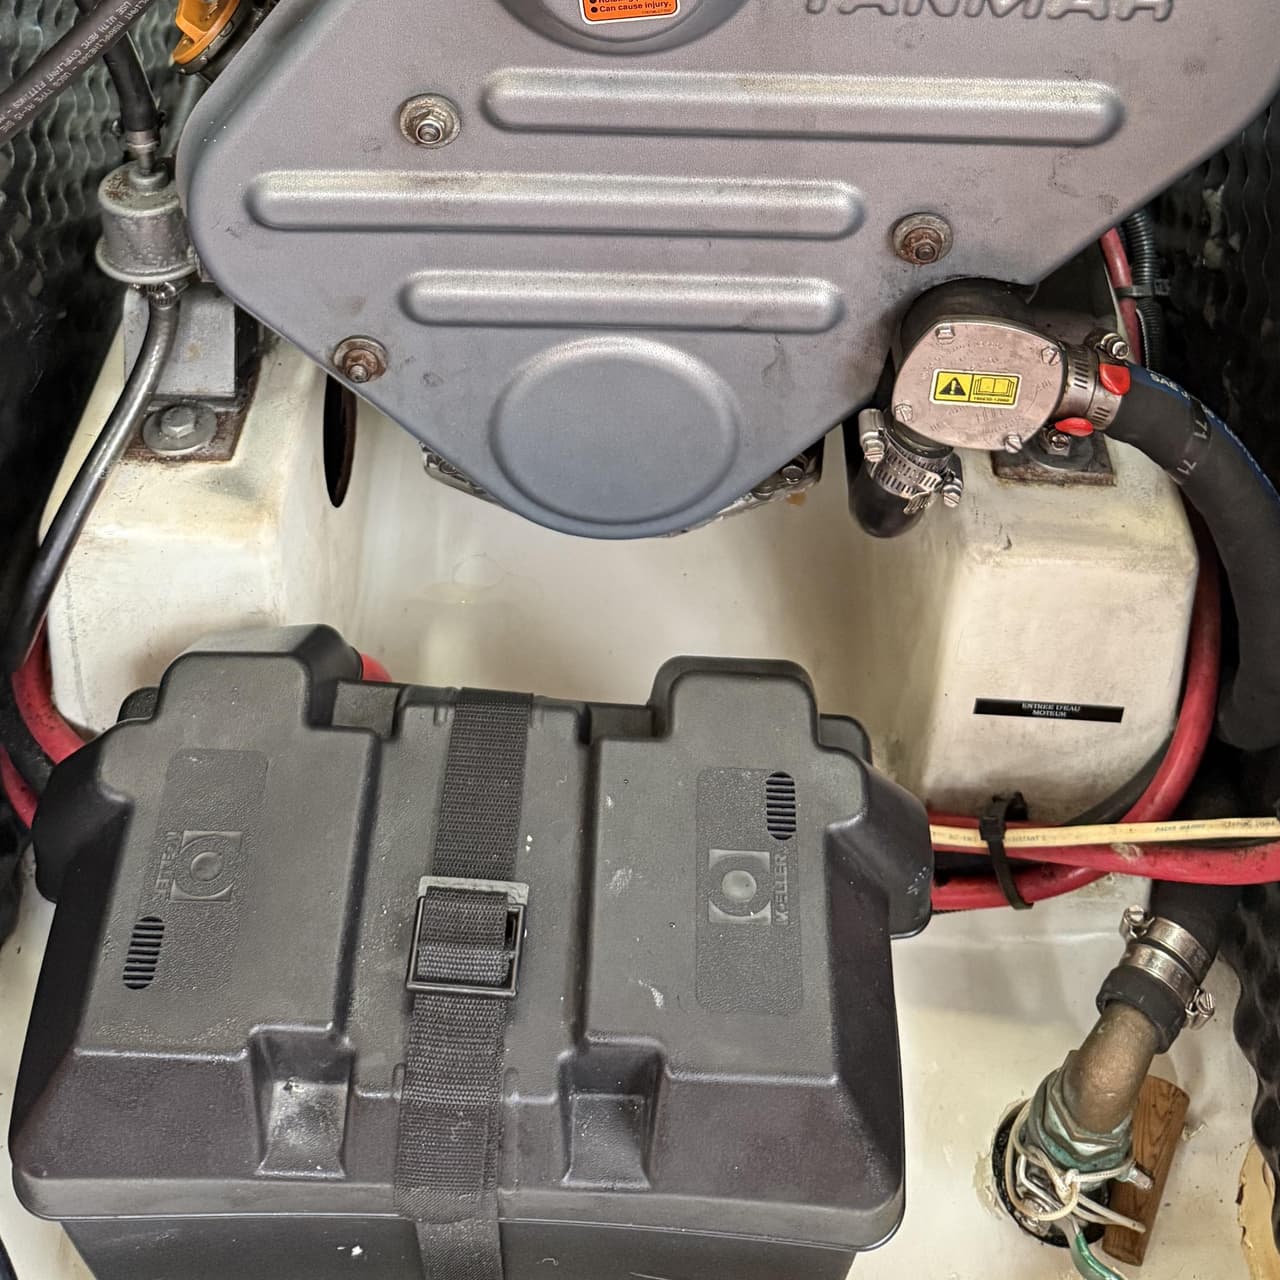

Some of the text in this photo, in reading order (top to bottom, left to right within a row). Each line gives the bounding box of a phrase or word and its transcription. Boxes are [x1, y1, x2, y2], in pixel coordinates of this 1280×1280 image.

[115, 0, 131, 16] USE
[599, 0, 672, 13] Can cause injury.
[96, 13, 117, 33] WITH
[46, 49, 81, 81] COMPLIANT
[13, 81, 47, 109] FITTINGS
[33, 85, 54, 105] TYPE
[1192, 419, 1210, 438] 71
[1175, 455, 1199, 479] 71
